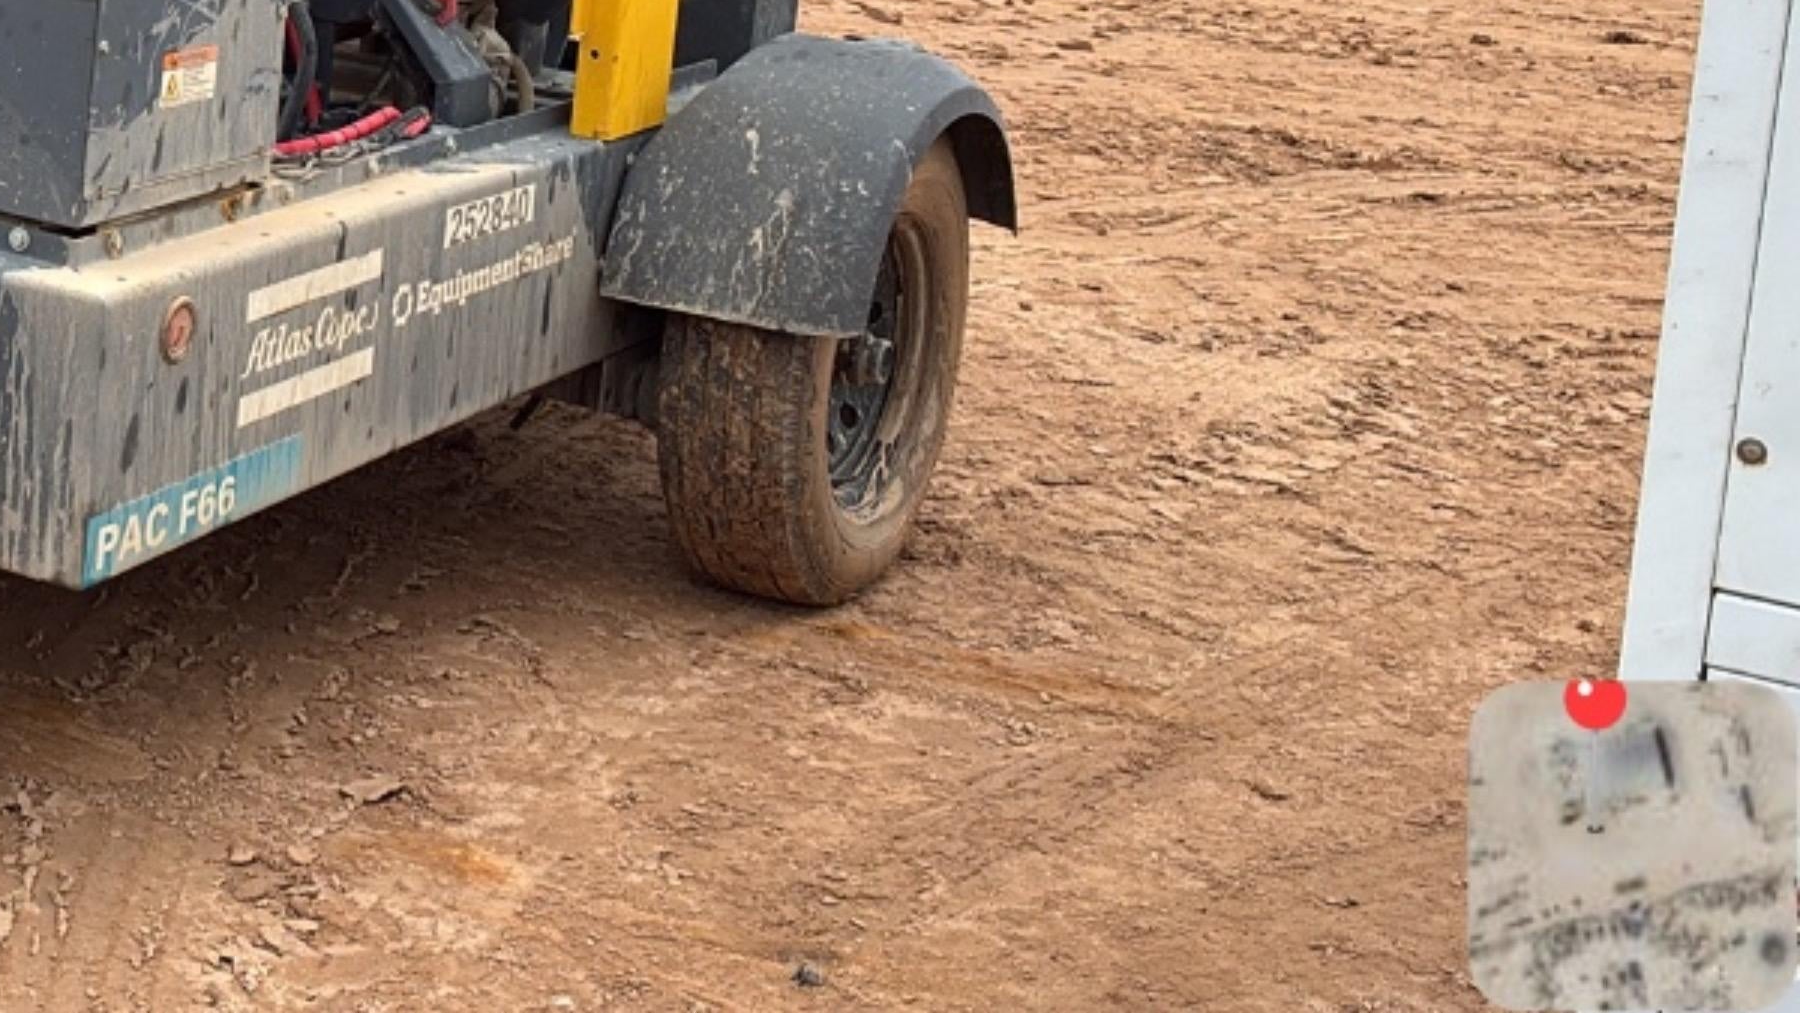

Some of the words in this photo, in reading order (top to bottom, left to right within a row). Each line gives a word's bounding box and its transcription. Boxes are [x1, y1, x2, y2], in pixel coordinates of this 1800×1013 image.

[450, 187, 532, 244] 252840
[415, 234, 576, 315] EquipmentShare
[241, 321, 314, 379] Atlas
[95, 502, 169, 571] PAC
[179, 475, 236, 535] F66
